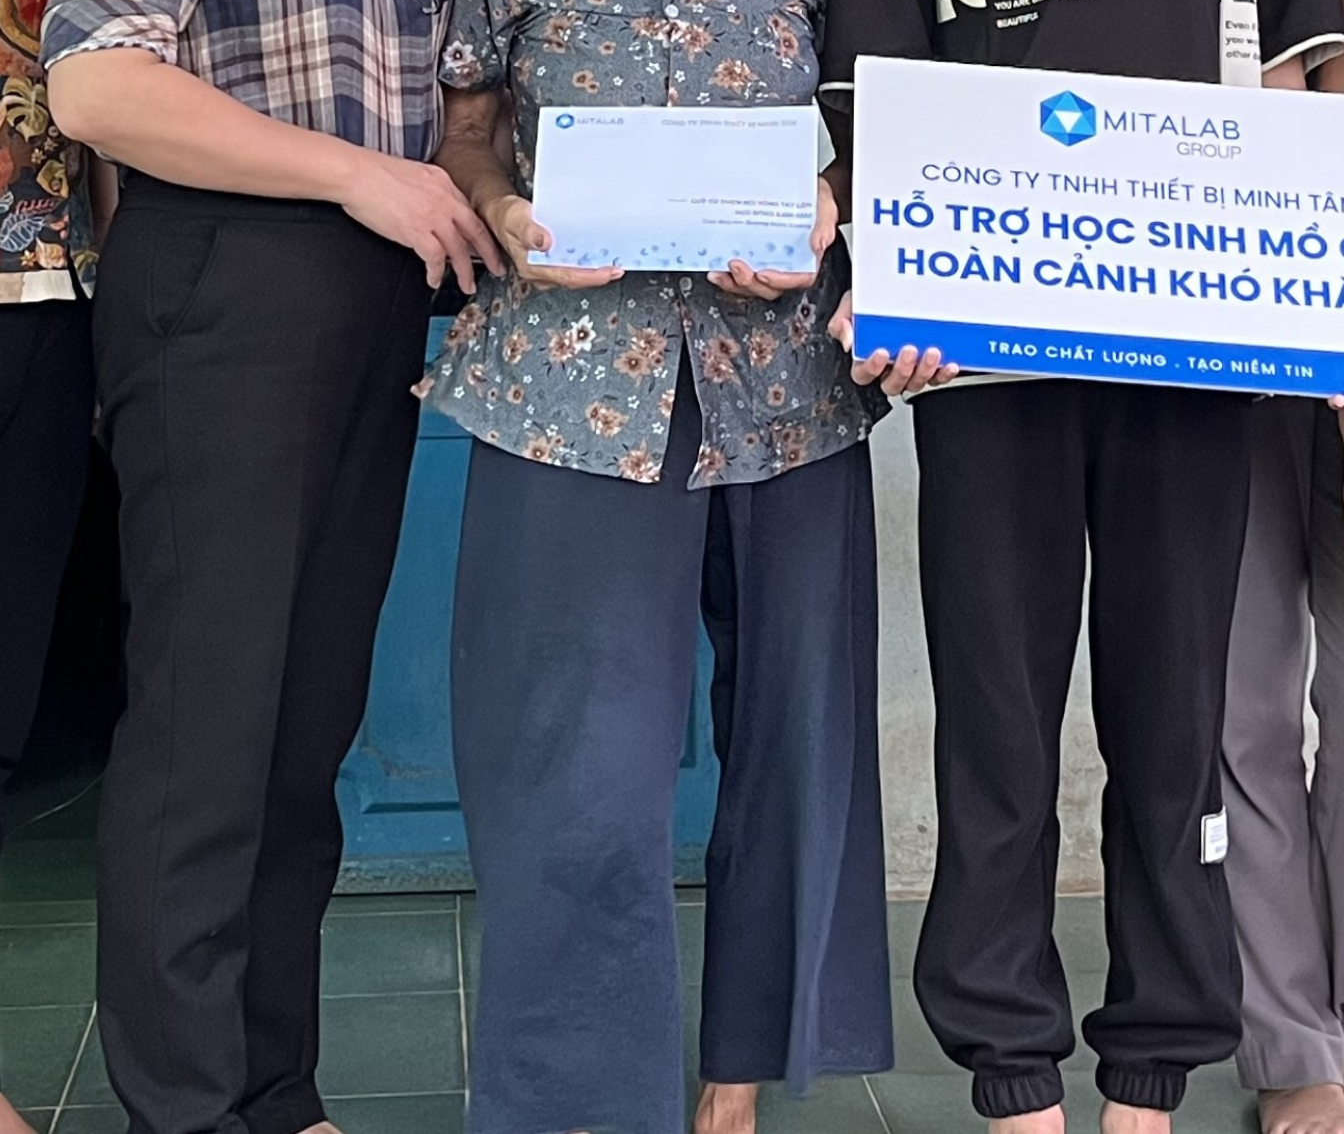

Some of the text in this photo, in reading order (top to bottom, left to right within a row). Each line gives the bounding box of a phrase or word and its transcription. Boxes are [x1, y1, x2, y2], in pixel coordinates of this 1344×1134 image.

[993, 0, 1013, 11] YOU
[1103, 109, 1241, 141] MITALAB
[1176, 141, 1242, 160] GROUP
[921, 161, 1002, 187] CÔNG
[1009, 170, 1040, 189] TY
[1047, 173, 1118, 196] TNHH
[1126, 177, 1195, 202] THIẾT
[1203, 185, 1226, 209] BỊ
[1233, 188, 1301, 210] MINH
[872, 190, 935, 229] HỖ
[945, 203, 1031, 244] TRỢ
[1041, 211, 1135, 250] HỌC
[1146, 220, 1247, 254] SINH
[1258, 221, 1328, 260] MỒ
[897, 245, 1021, 284] HOÀN
[1033, 252, 1157, 295] CẢNH
[1168, 268, 1261, 302] KHÓ
[988, 340, 1038, 358] TRAO
[1102, 351, 1168, 368] LƯỢNG
[1187, 356, 1224, 374] TẠO
[1283, 364, 1315, 379] TIN
